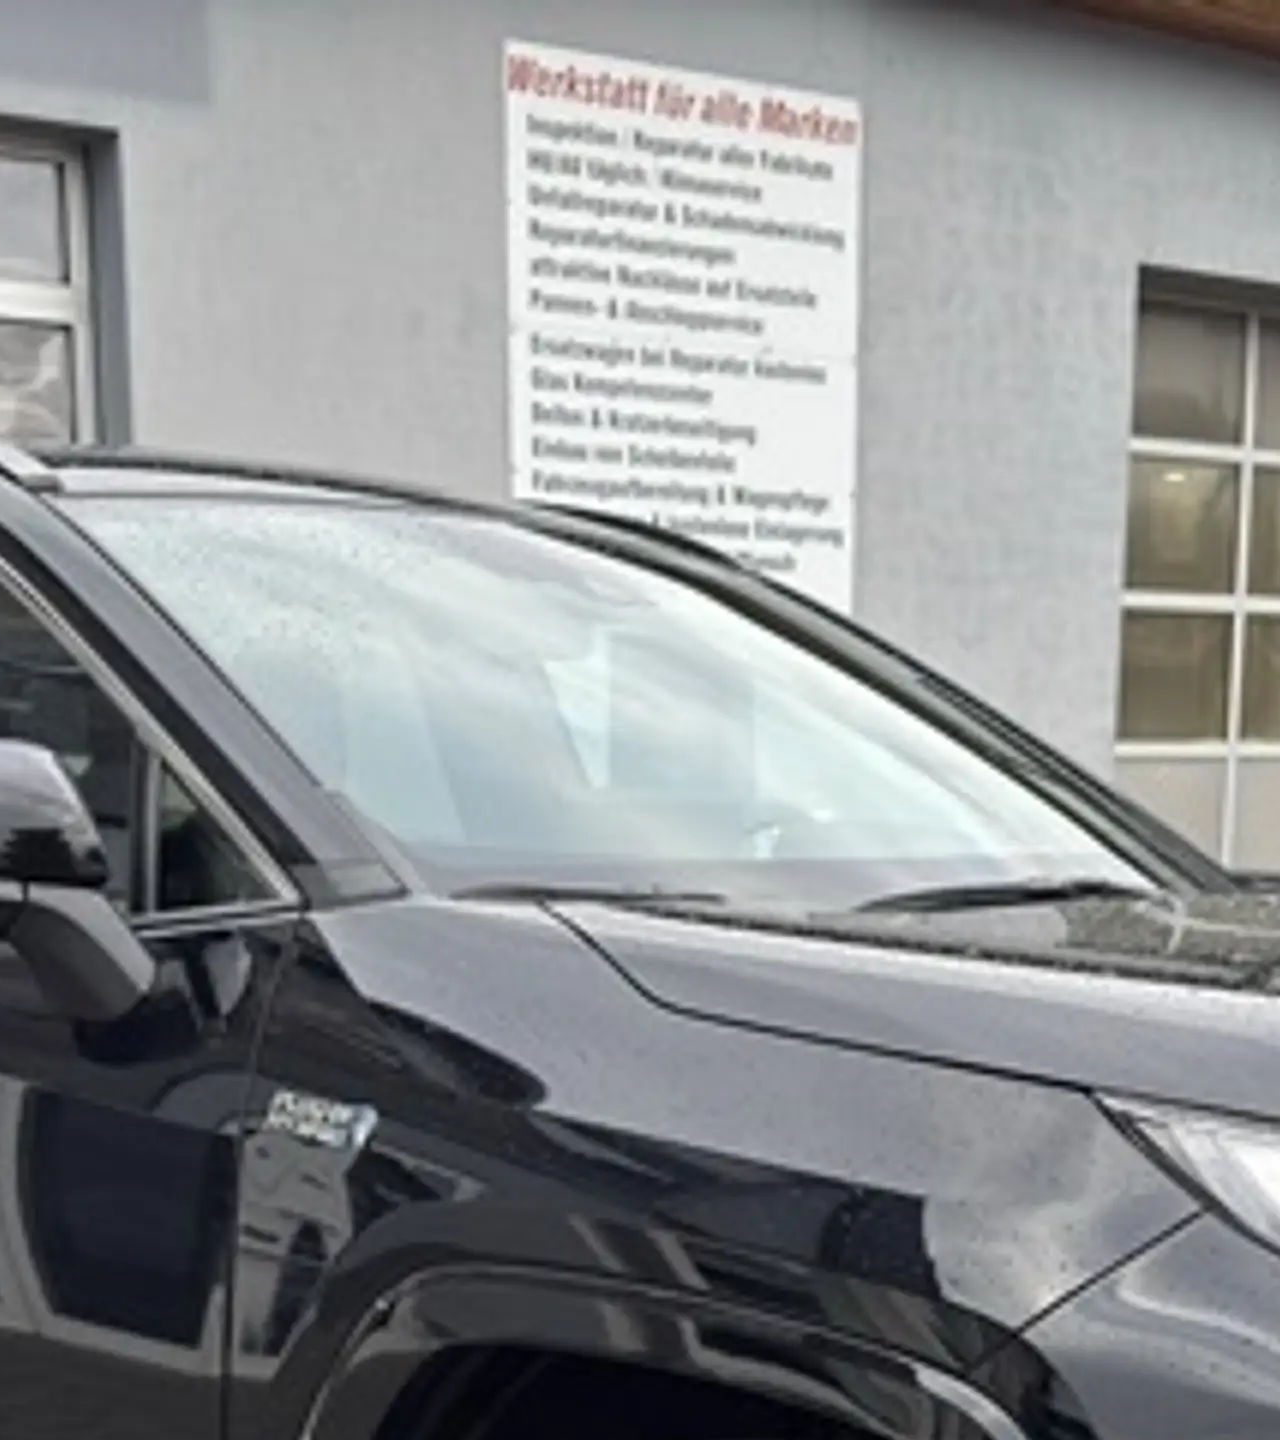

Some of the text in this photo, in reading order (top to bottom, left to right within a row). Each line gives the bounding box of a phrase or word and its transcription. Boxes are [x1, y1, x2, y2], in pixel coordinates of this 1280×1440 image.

[507, 54, 860, 145] Werkstatt für alle Marken
